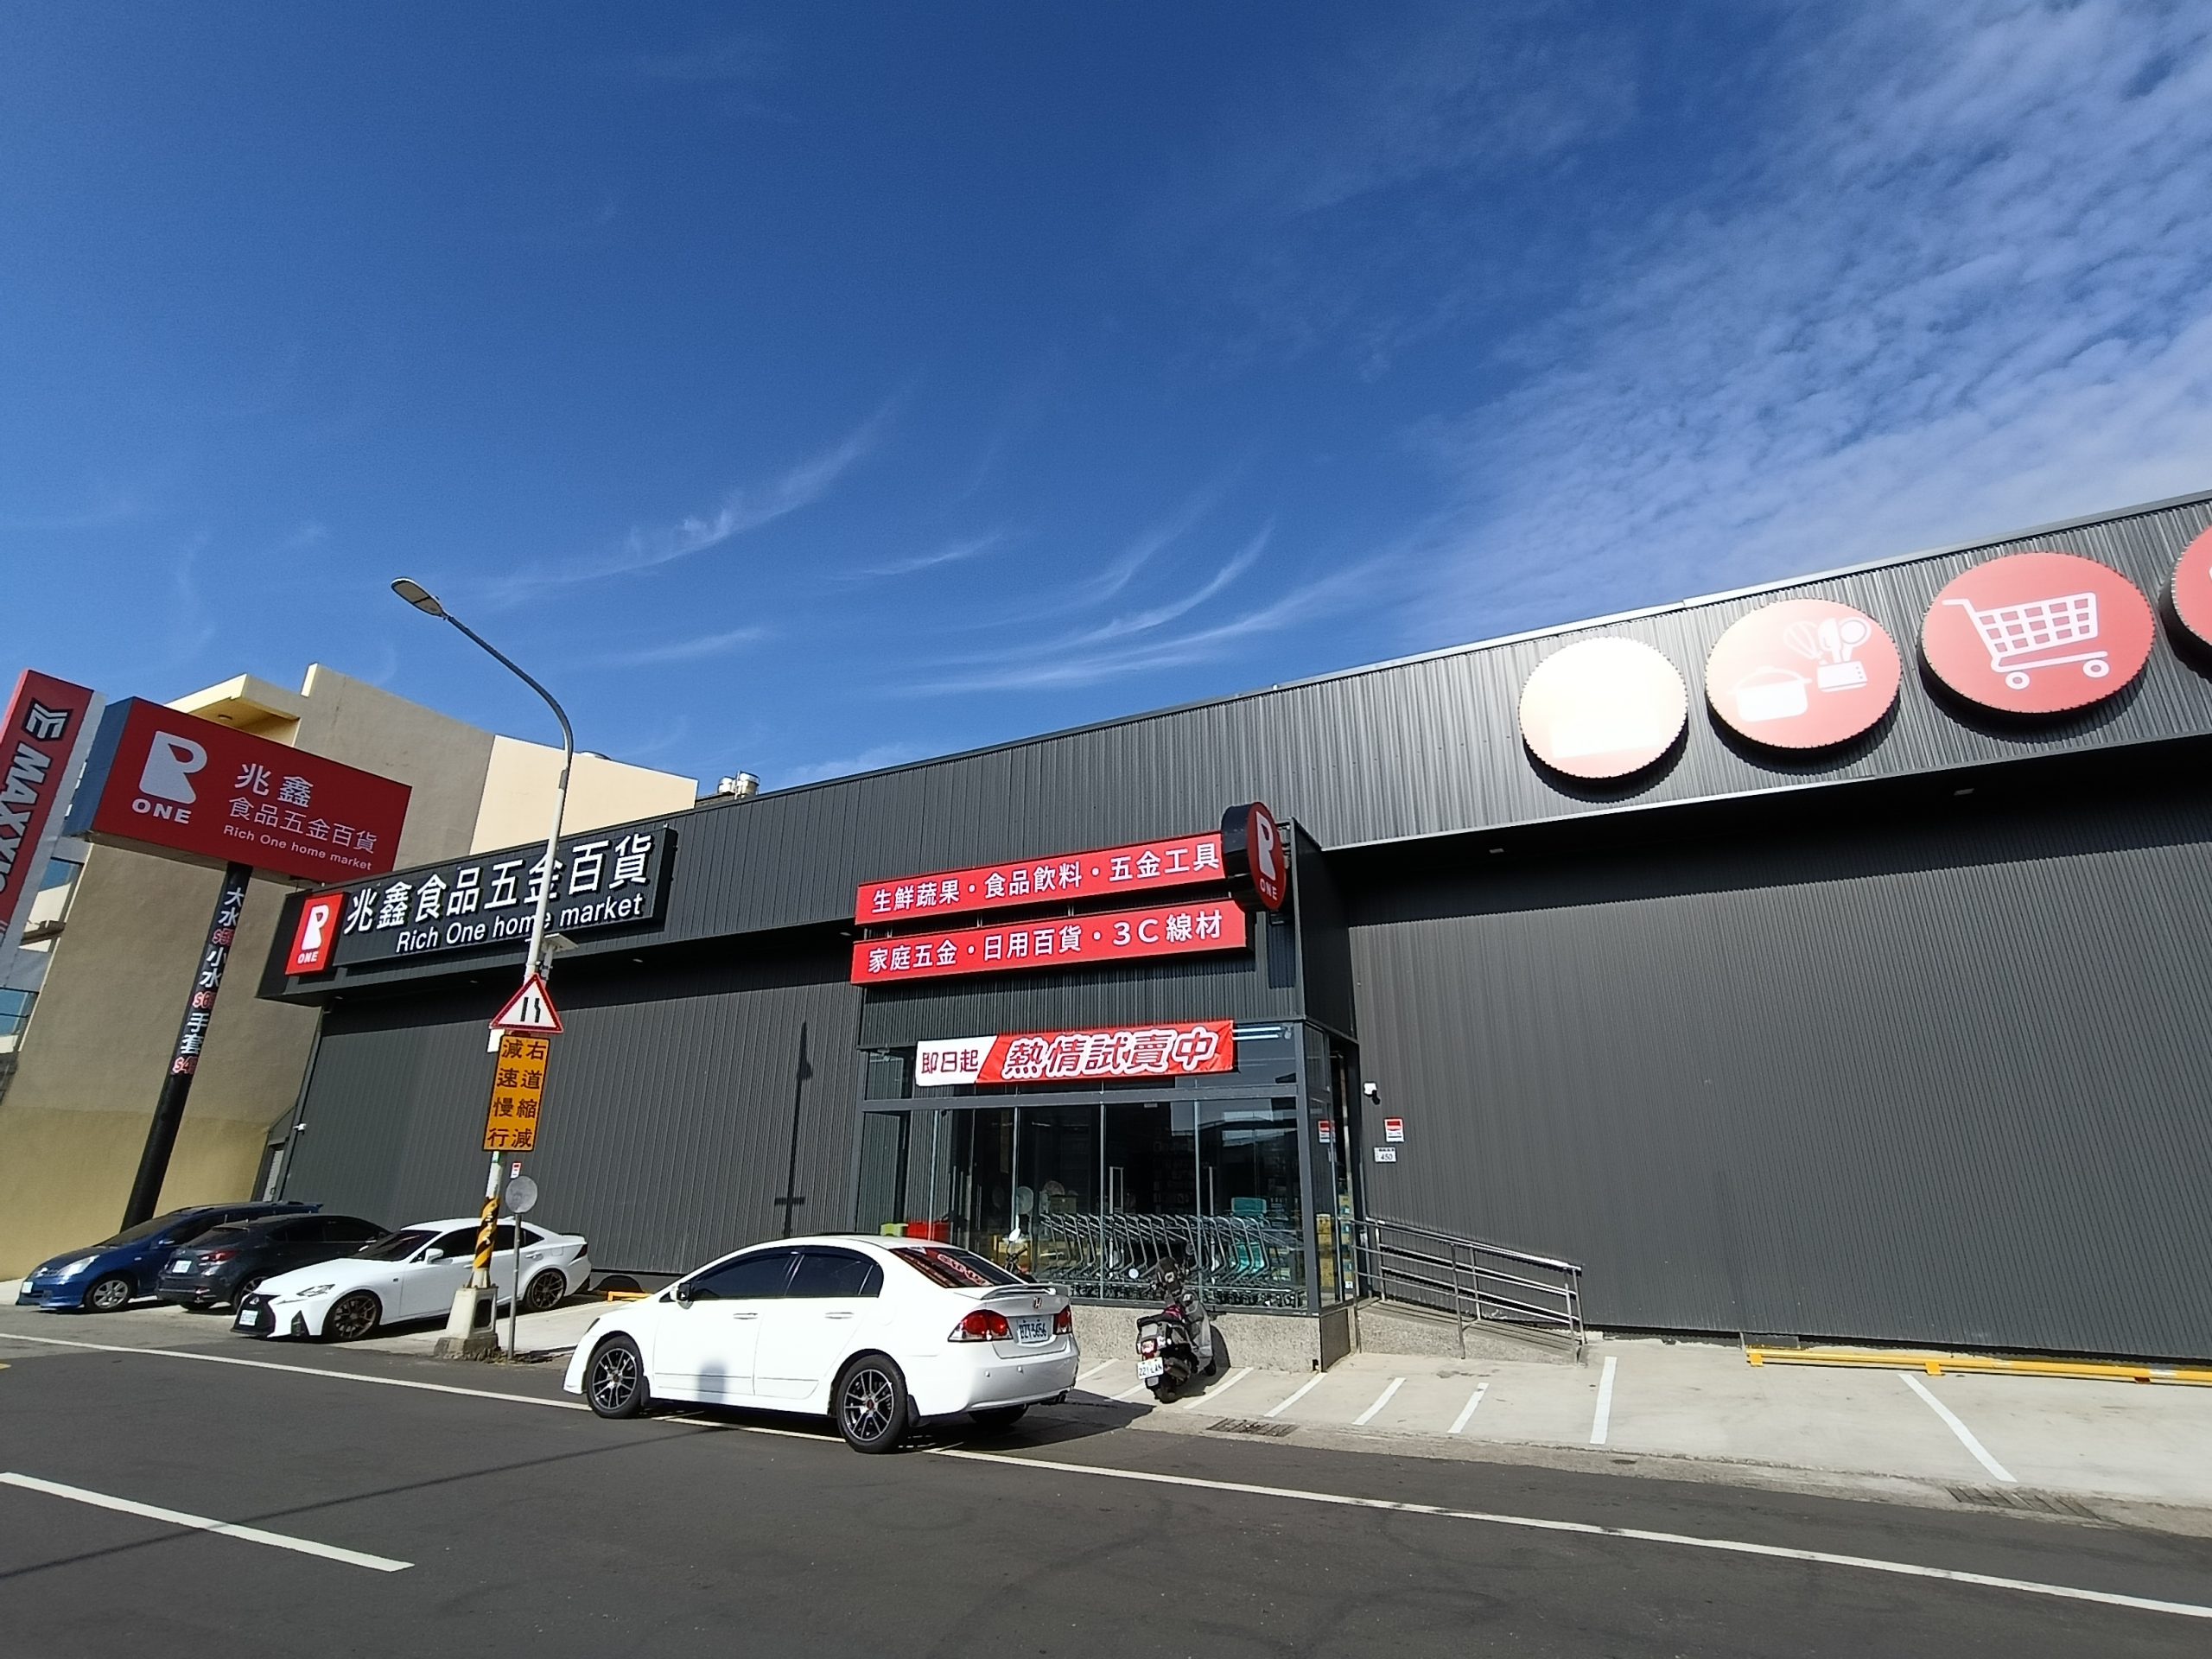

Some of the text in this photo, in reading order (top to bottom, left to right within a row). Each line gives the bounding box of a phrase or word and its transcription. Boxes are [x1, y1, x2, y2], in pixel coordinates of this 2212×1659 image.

[131, 798, 192, 824] ONE
[234, 763, 314, 808] 兆鑫
[223, 824, 372, 871] Rich One home market
[228, 797, 378, 855] 食品五金百貨
[343, 833, 652, 935] 兆鑫食品五金百貨
[1259, 877, 1278, 901] ONE
[396, 927, 439, 954] Rich
[446, 915, 486, 944] One
[559, 893, 644, 927] market
[296, 950, 319, 965] ONE
[920, 1025, 1219, 1081] 即日起 熱情試賣中
[487, 1039, 524, 1147] 減速慢行
[512, 1041, 546, 1148] 右道縮減
